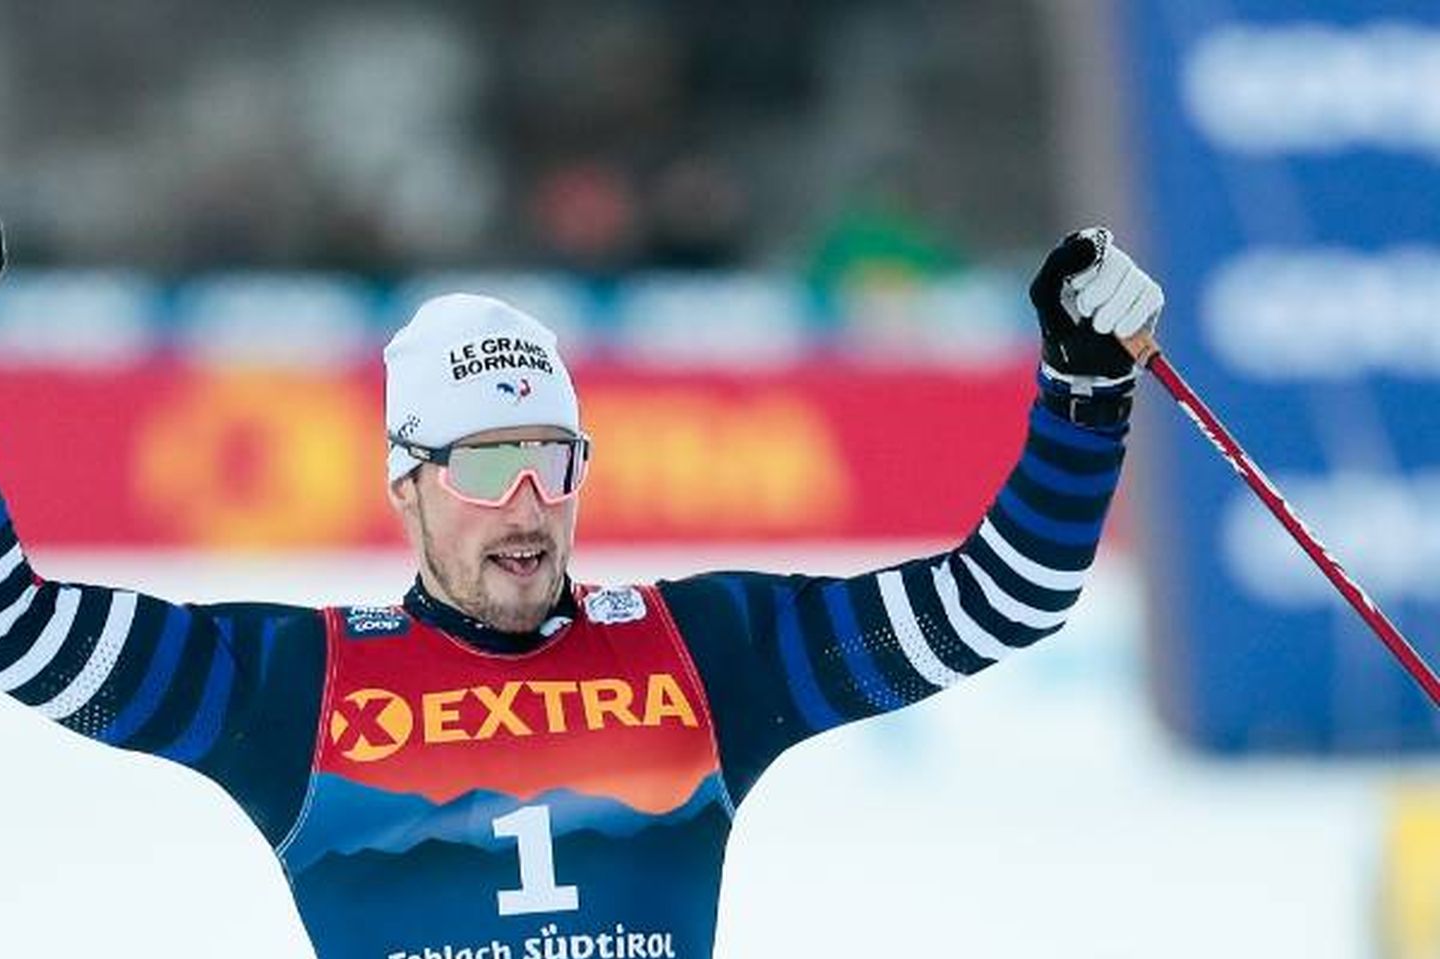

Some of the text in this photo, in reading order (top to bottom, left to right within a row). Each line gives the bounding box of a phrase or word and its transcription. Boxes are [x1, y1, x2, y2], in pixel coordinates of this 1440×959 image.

[450, 344, 476, 365] LE
[452, 353, 553, 380] BORNAND
[422, 674, 699, 744] EXTRA
[491, 804, 580, 916] 1
